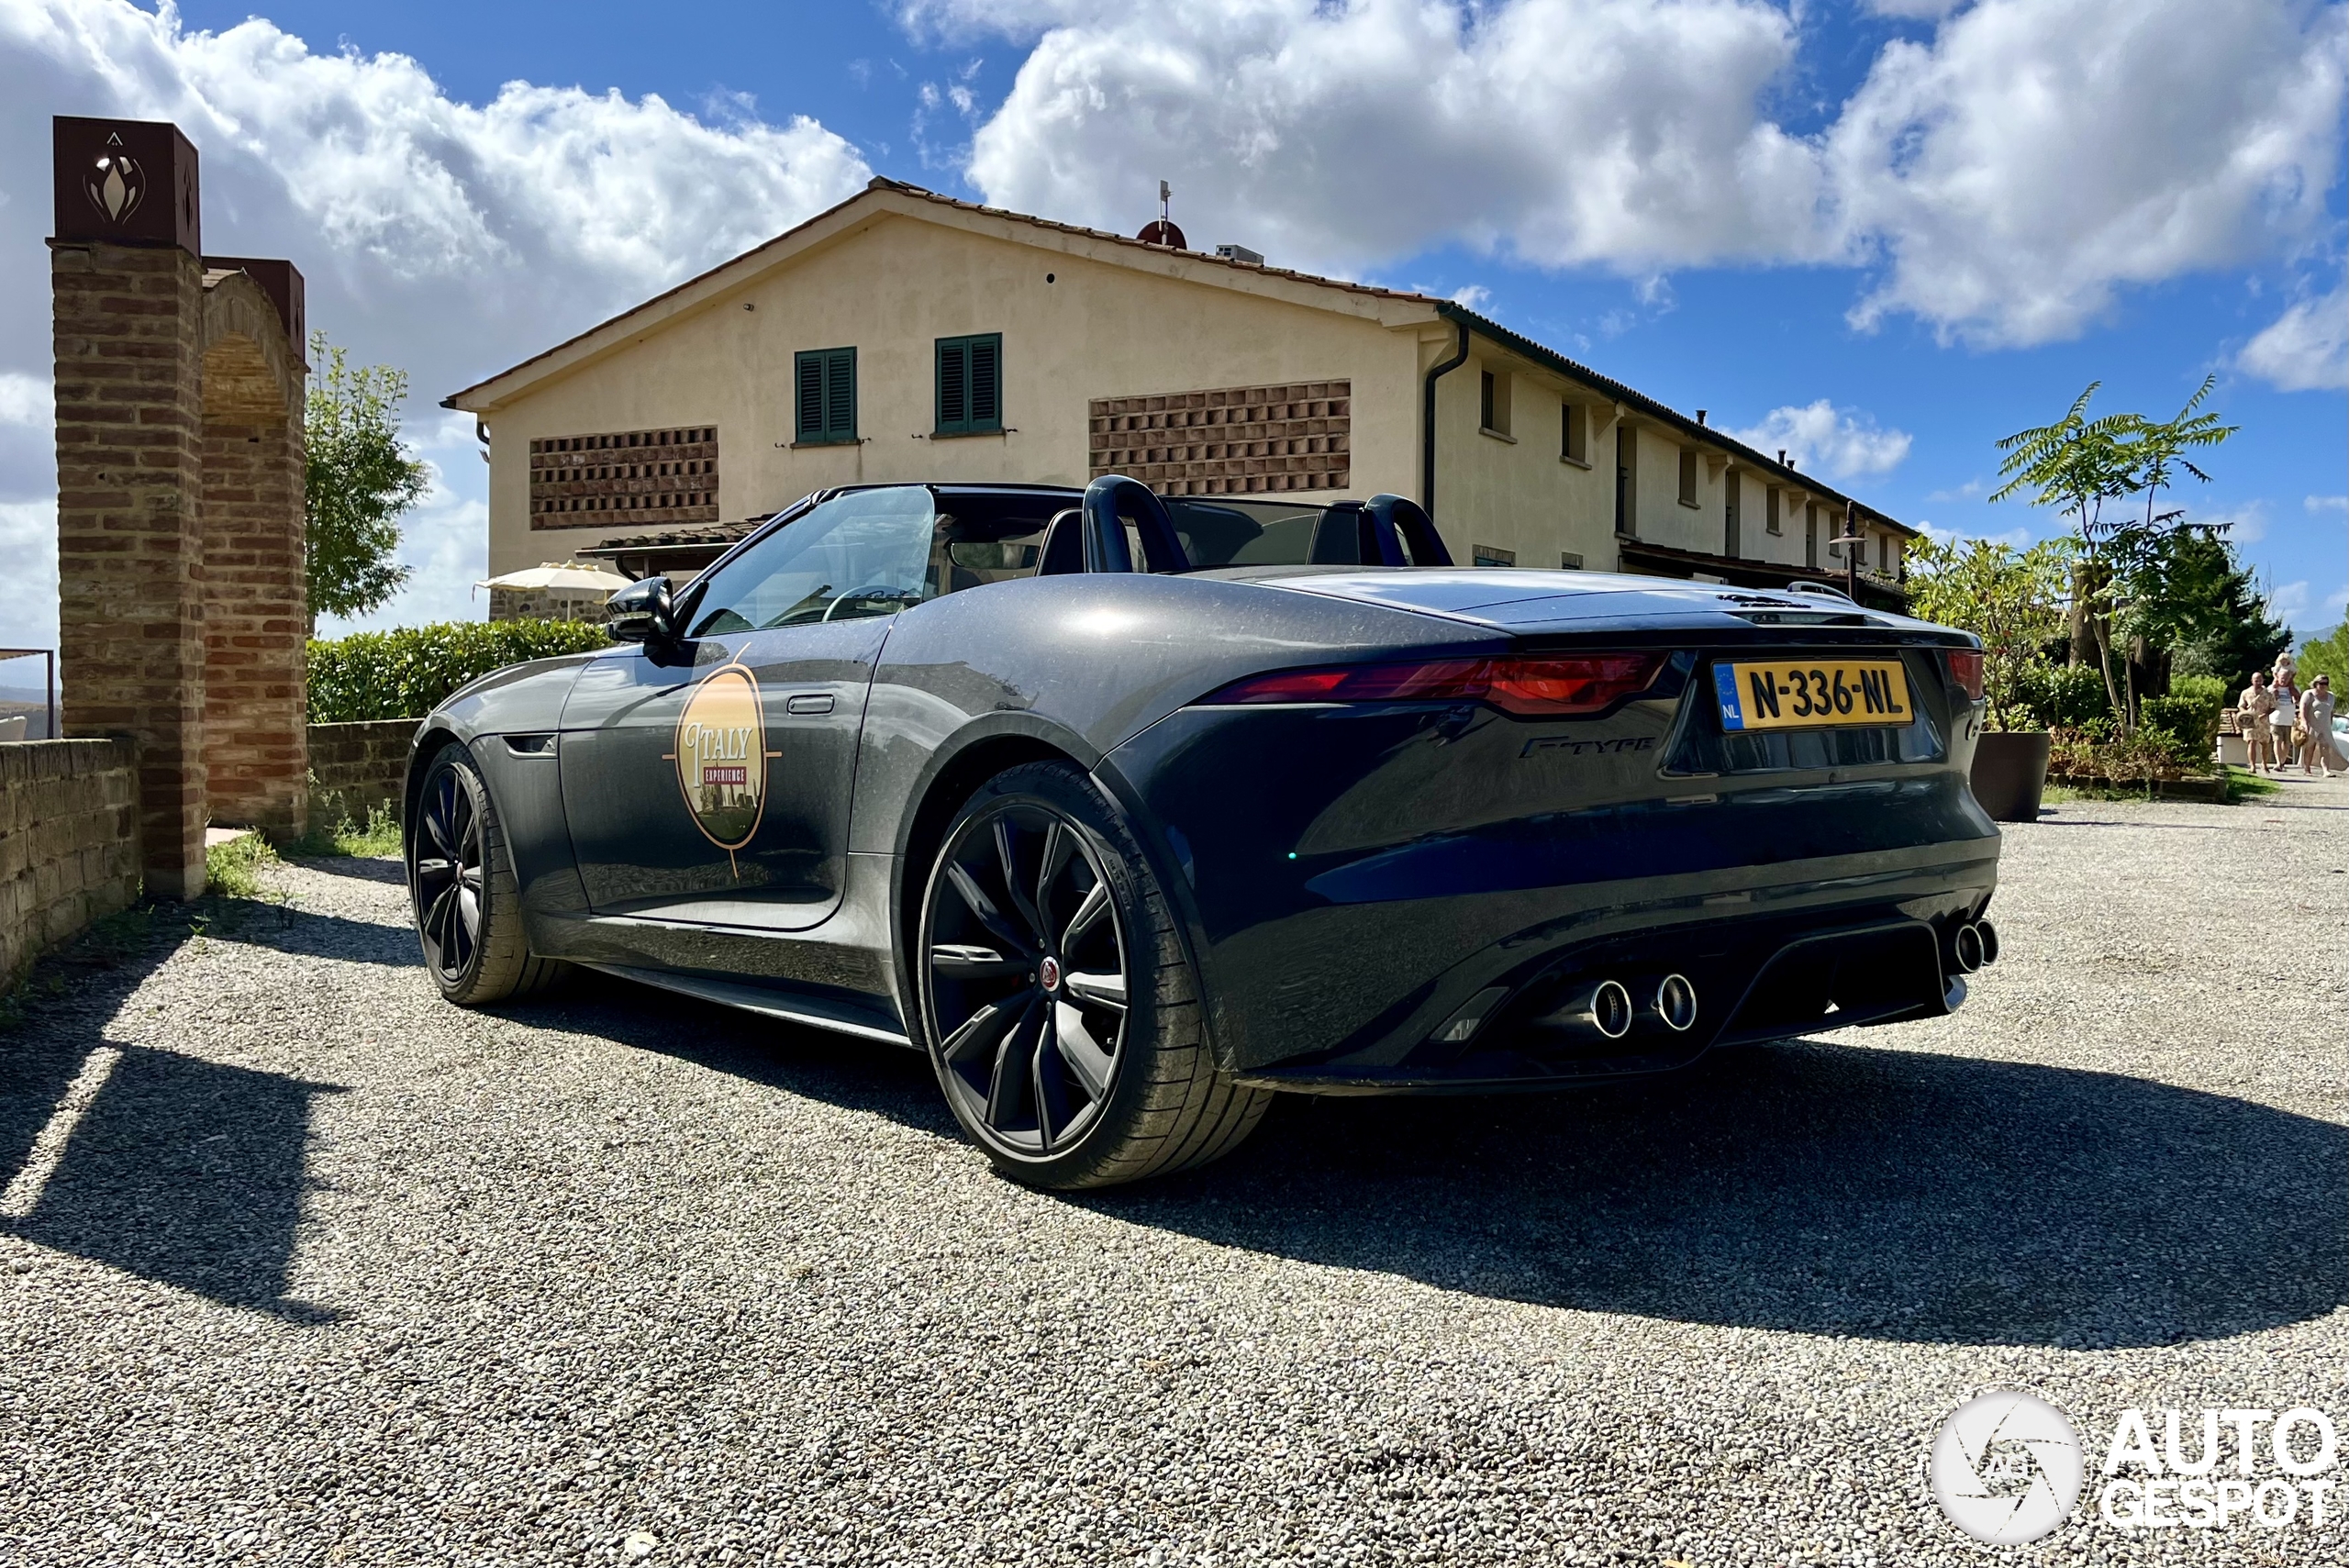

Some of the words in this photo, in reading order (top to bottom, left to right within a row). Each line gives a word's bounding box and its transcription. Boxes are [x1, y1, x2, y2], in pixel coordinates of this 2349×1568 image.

[1750, 670, 1903, 718] N-336-NL
[1722, 705, 1739, 719] NL
[1519, 736, 1654, 759] F-TYPE
[706, 769, 744, 782] EXPERIENCE
